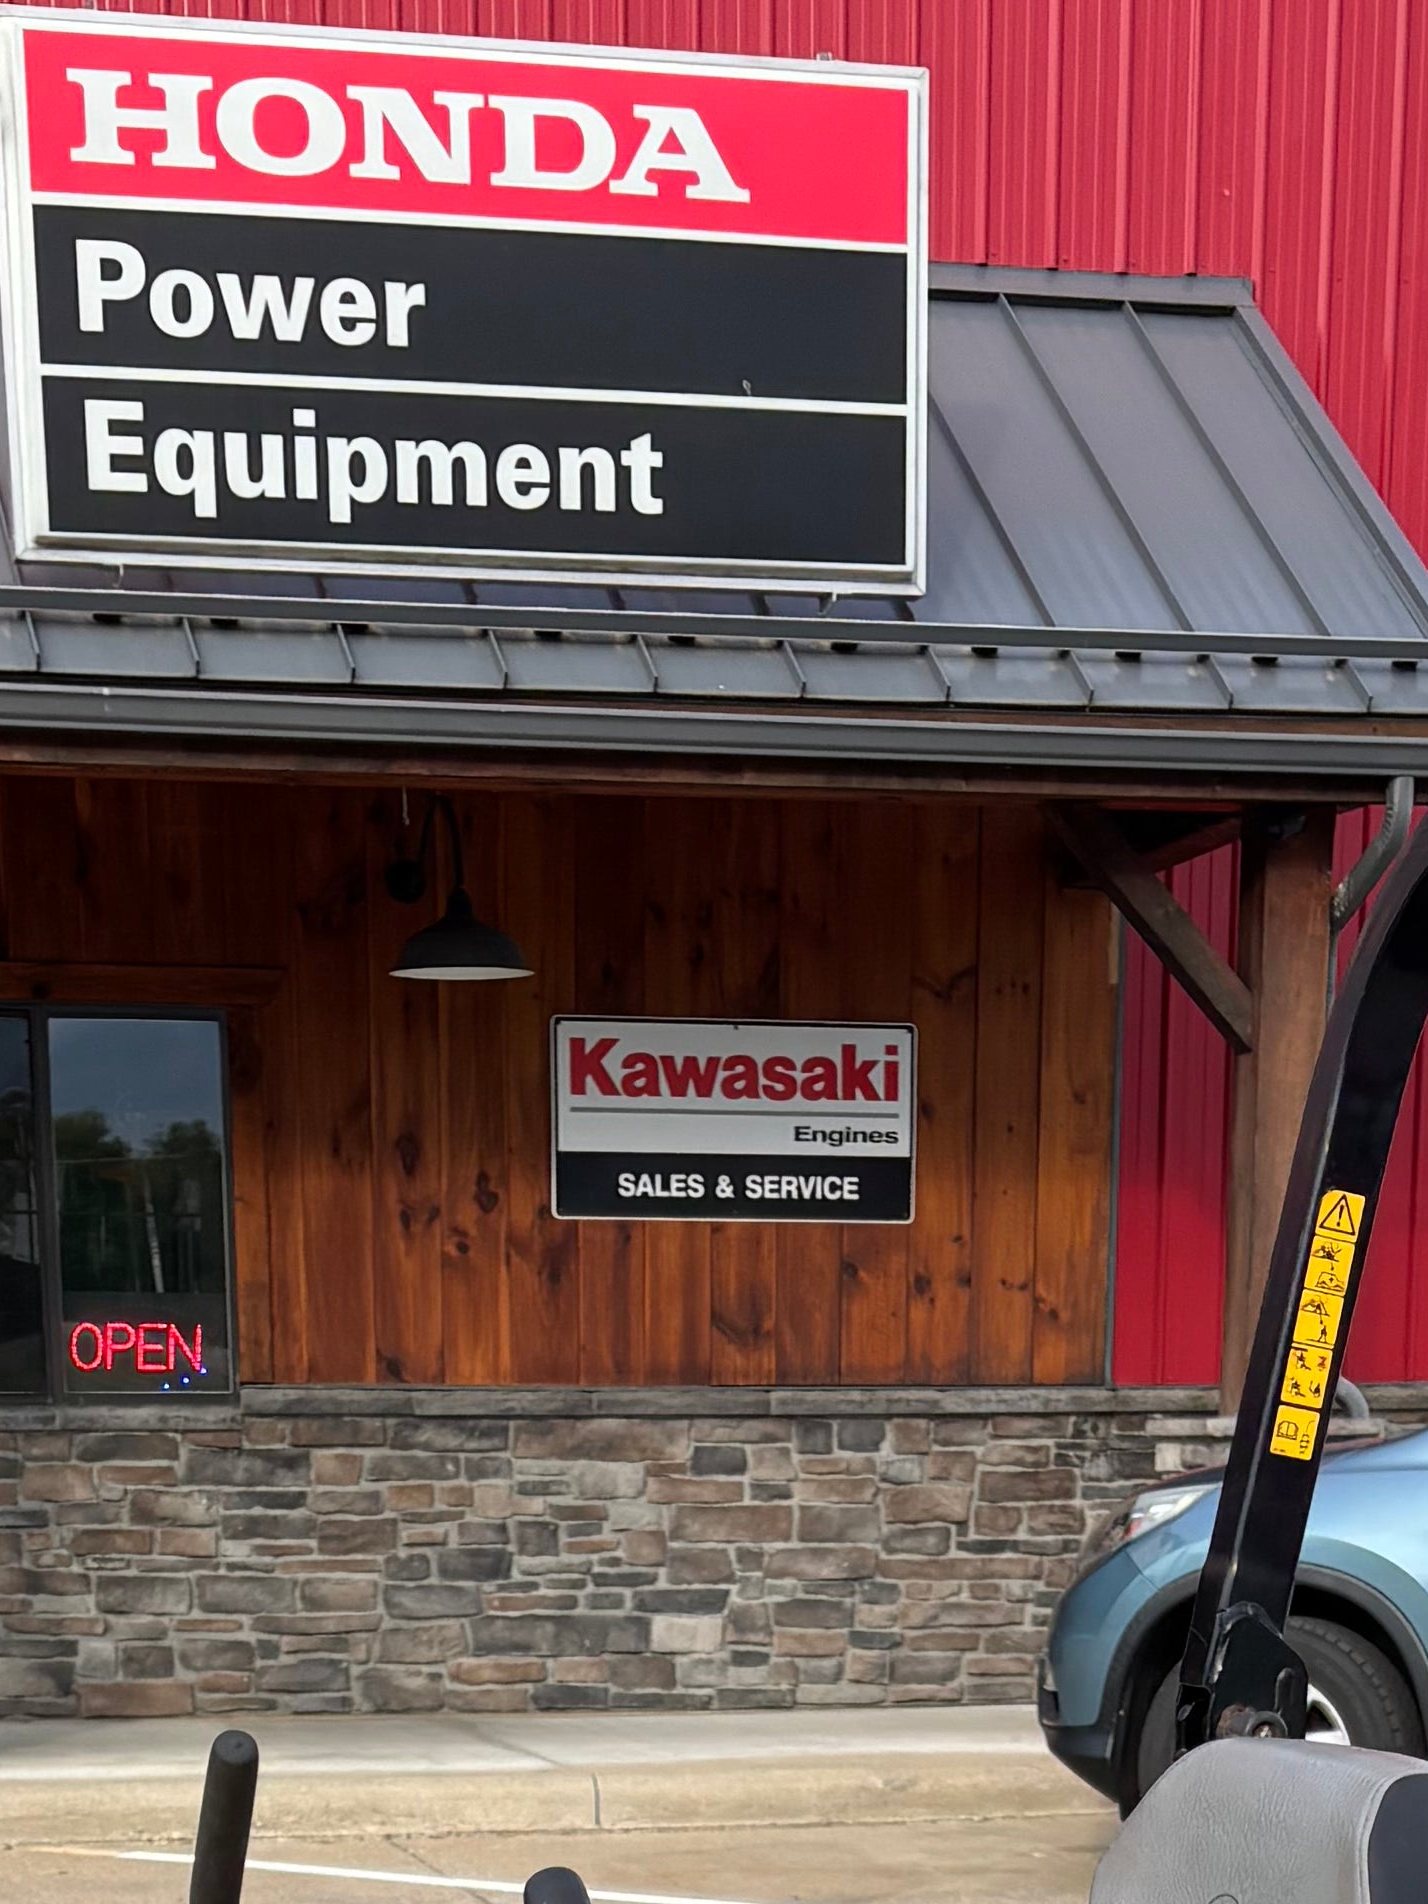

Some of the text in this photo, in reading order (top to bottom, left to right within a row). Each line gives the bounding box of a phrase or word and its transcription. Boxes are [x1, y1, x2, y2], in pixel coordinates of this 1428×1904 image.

[65, 66, 750, 203] HONDA
[74, 237, 427, 348] Power
[83, 398, 664, 524] Equipment
[568, 1036, 900, 1102] Kawasaki
[793, 1125, 900, 1147] Engines
[617, 1172, 861, 1201] SALES & SERVICE
[69, 1321, 203, 1373] OPEN
